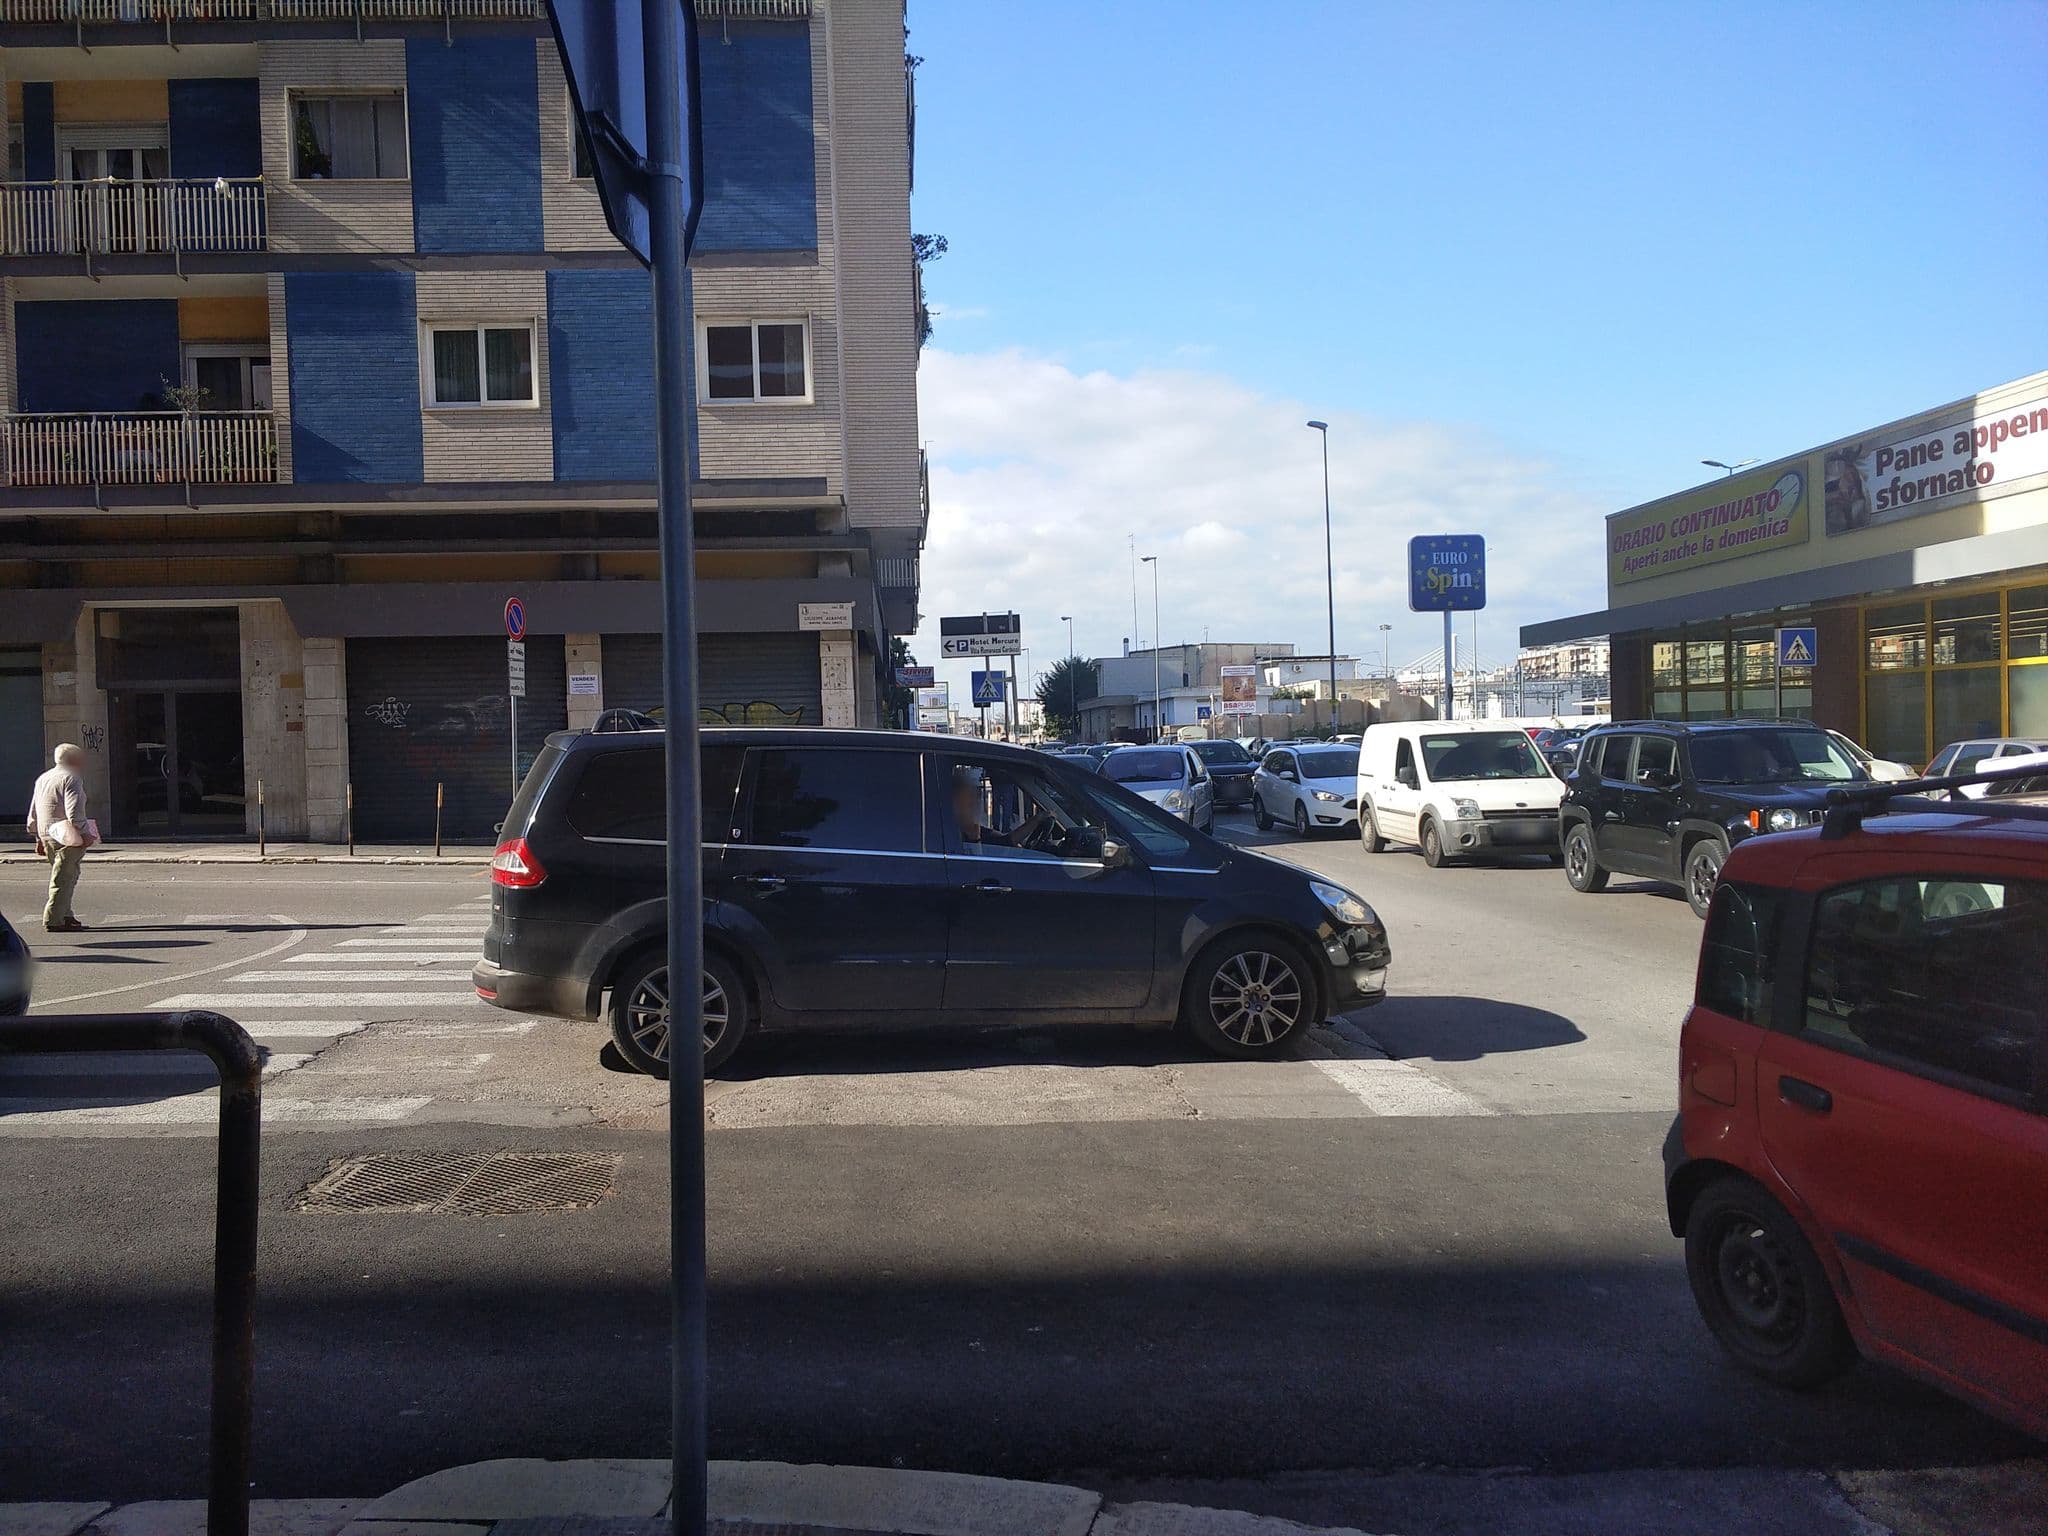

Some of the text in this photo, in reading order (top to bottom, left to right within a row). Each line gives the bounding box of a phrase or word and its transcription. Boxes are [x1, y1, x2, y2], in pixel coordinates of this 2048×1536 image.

[1876, 439, 1944, 477] Pane
[1876, 459, 1995, 510] sfornato
[1614, 488, 1781, 553] ORARIO CONTINUATO
[1432, 551, 1468, 565] EURO
[1623, 517, 1789, 574] Aperti anche la domenica
[1427, 567, 1473, 595] Spin
[970, 637, 1019, 646] Hotel Mercure
